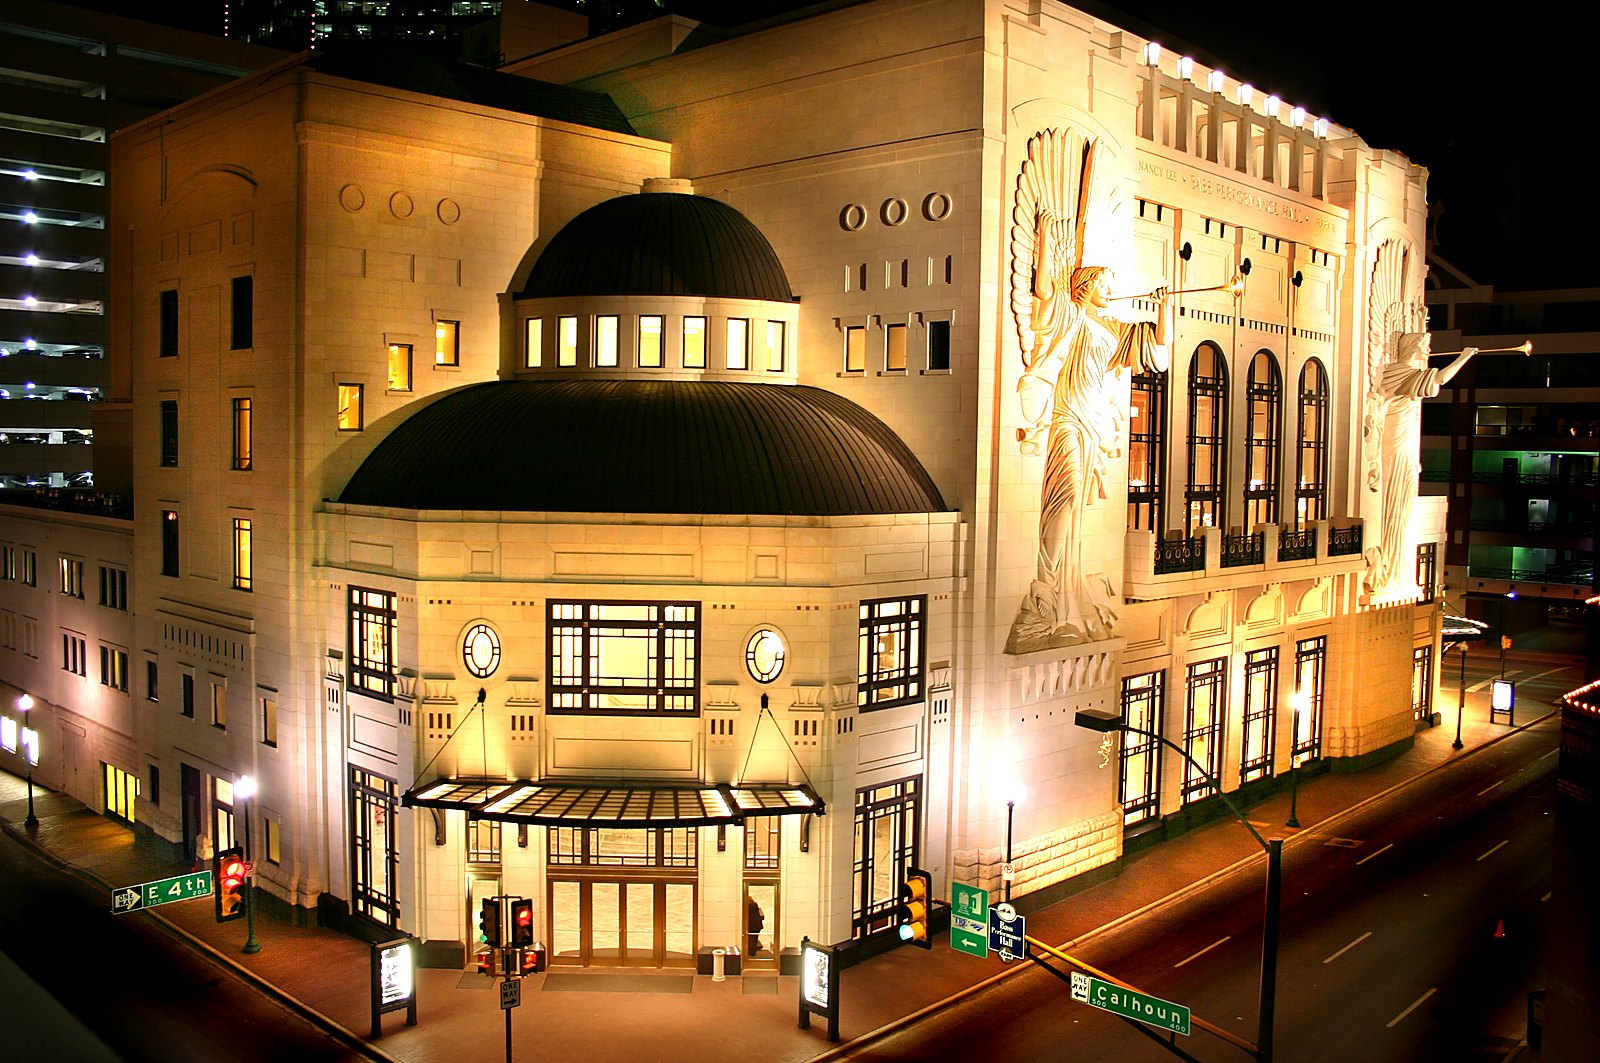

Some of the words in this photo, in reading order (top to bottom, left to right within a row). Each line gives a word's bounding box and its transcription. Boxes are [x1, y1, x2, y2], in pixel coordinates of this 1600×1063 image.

[1138, 160, 1164, 178] NANCY
[1166, 169, 1178, 182] LEE
[1190, 174, 1213, 195] BASS
[1282, 205, 1303, 223] HALL
[148, 886, 159, 899] E
[168, 878, 206, 896] 4th
[192, 888, 208, 896] 200
[119, 892, 134, 901] ONE
[119, 899, 134, 907] WAY
[147, 898, 163, 906] 300
[999, 935, 1013, 948] Hall
[1073, 975, 1088, 985] ONE
[503, 981, 518, 991] ONE
[1072, 983, 1087, 992] WAY
[503, 990, 518, 998] WAY
[1091, 998, 1107, 1008] 500
[1097, 986, 1181, 1024] Calhoun
[1169, 1023, 1186, 1032] 400
